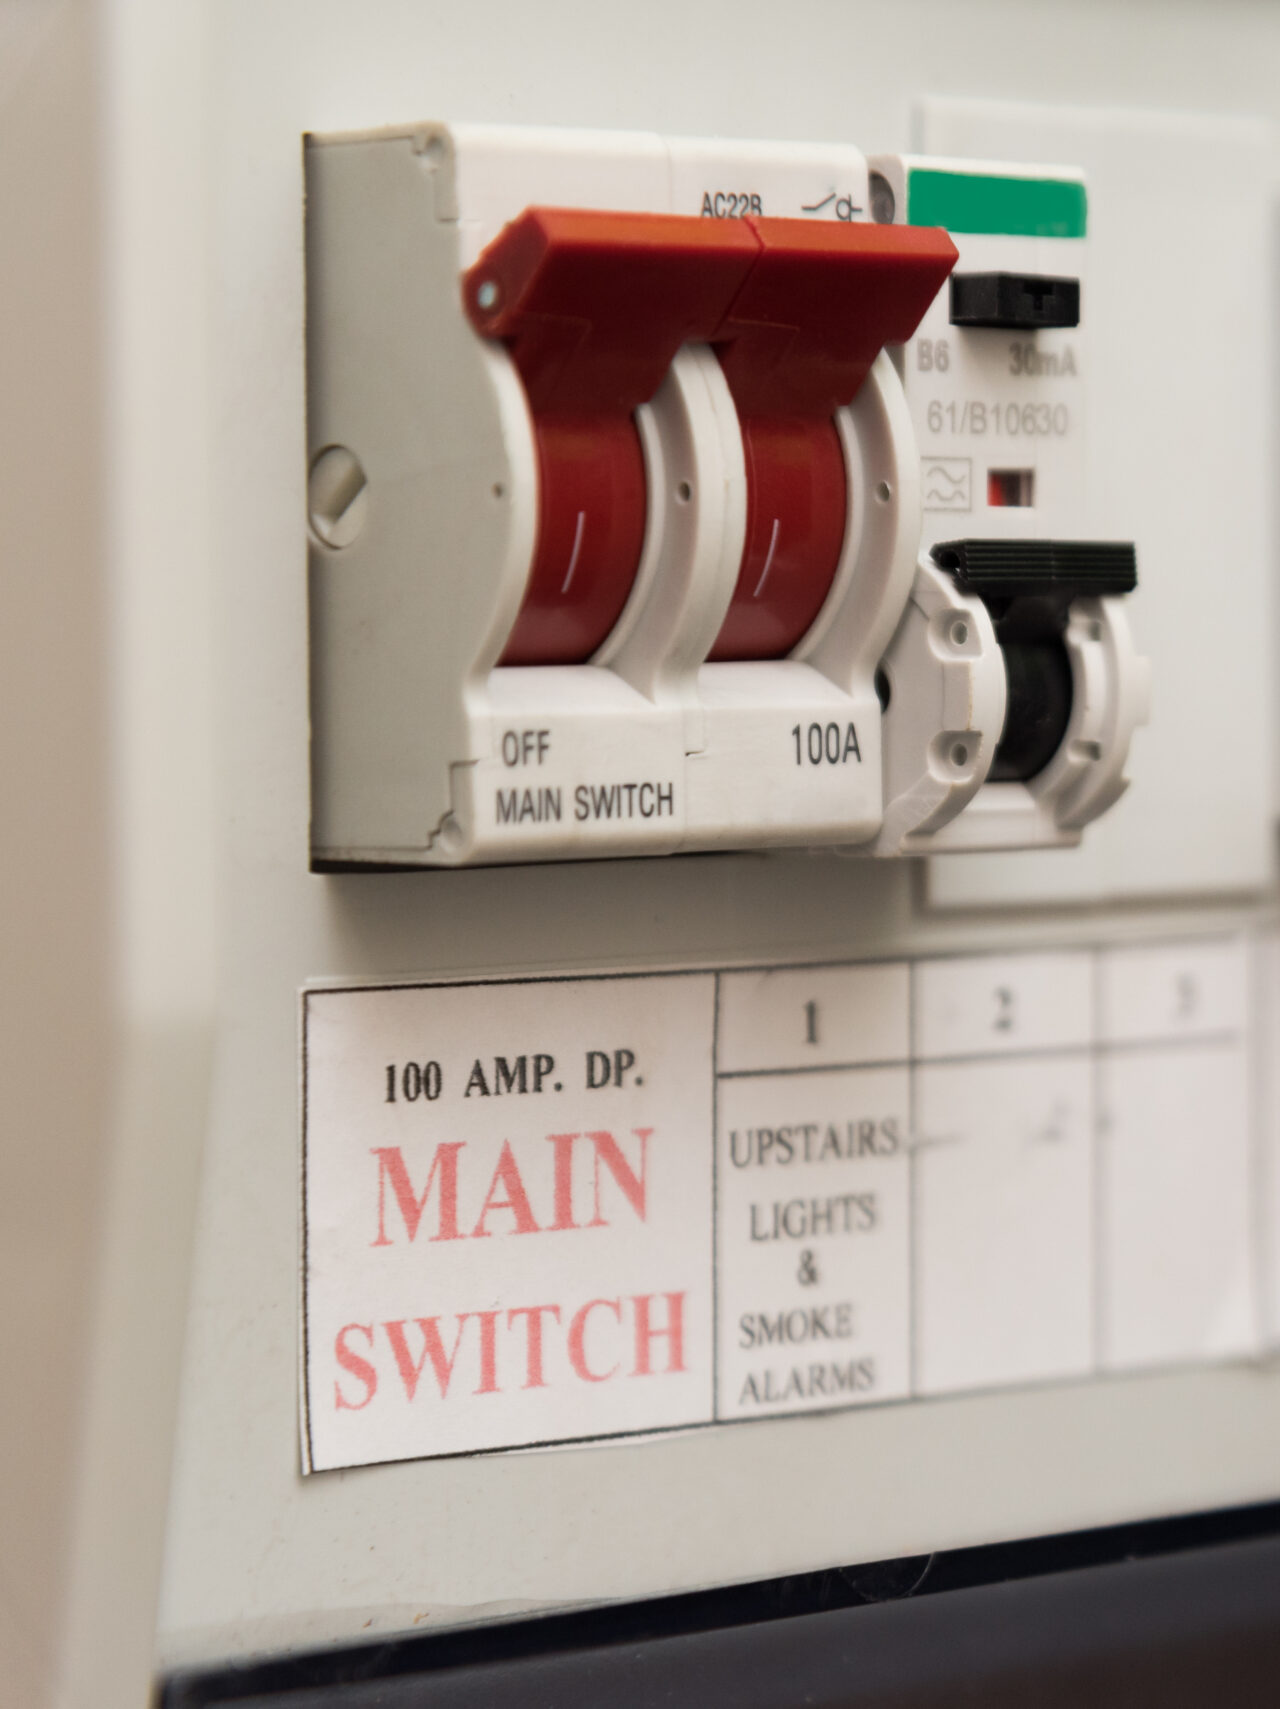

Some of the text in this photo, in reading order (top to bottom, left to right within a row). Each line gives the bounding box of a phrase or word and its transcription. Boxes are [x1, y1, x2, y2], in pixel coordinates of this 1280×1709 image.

[917, 338, 1078, 377] B6 30mA
[926, 401, 1069, 436] 61/B10630
[502, 729, 550, 767] OFF
[791, 722, 862, 765] 100A
[496, 781, 674, 824] MAIN SWITCH
[804, 1001, 819, 1044] 1
[993, 986, 1014, 1034] 2
[384, 1048, 644, 1103] 100 AMP. DP.
[729, 1117, 900, 1169] UPSTAIRS
[369, 1127, 656, 1248] MAIN
[749, 1194, 878, 1242] LIGHTS
[797, 1249, 820, 1286] &
[738, 1303, 854, 1350] SMOKE
[333, 1291, 689, 1412] SWITCH
[738, 1357, 876, 1406] ALARMS
